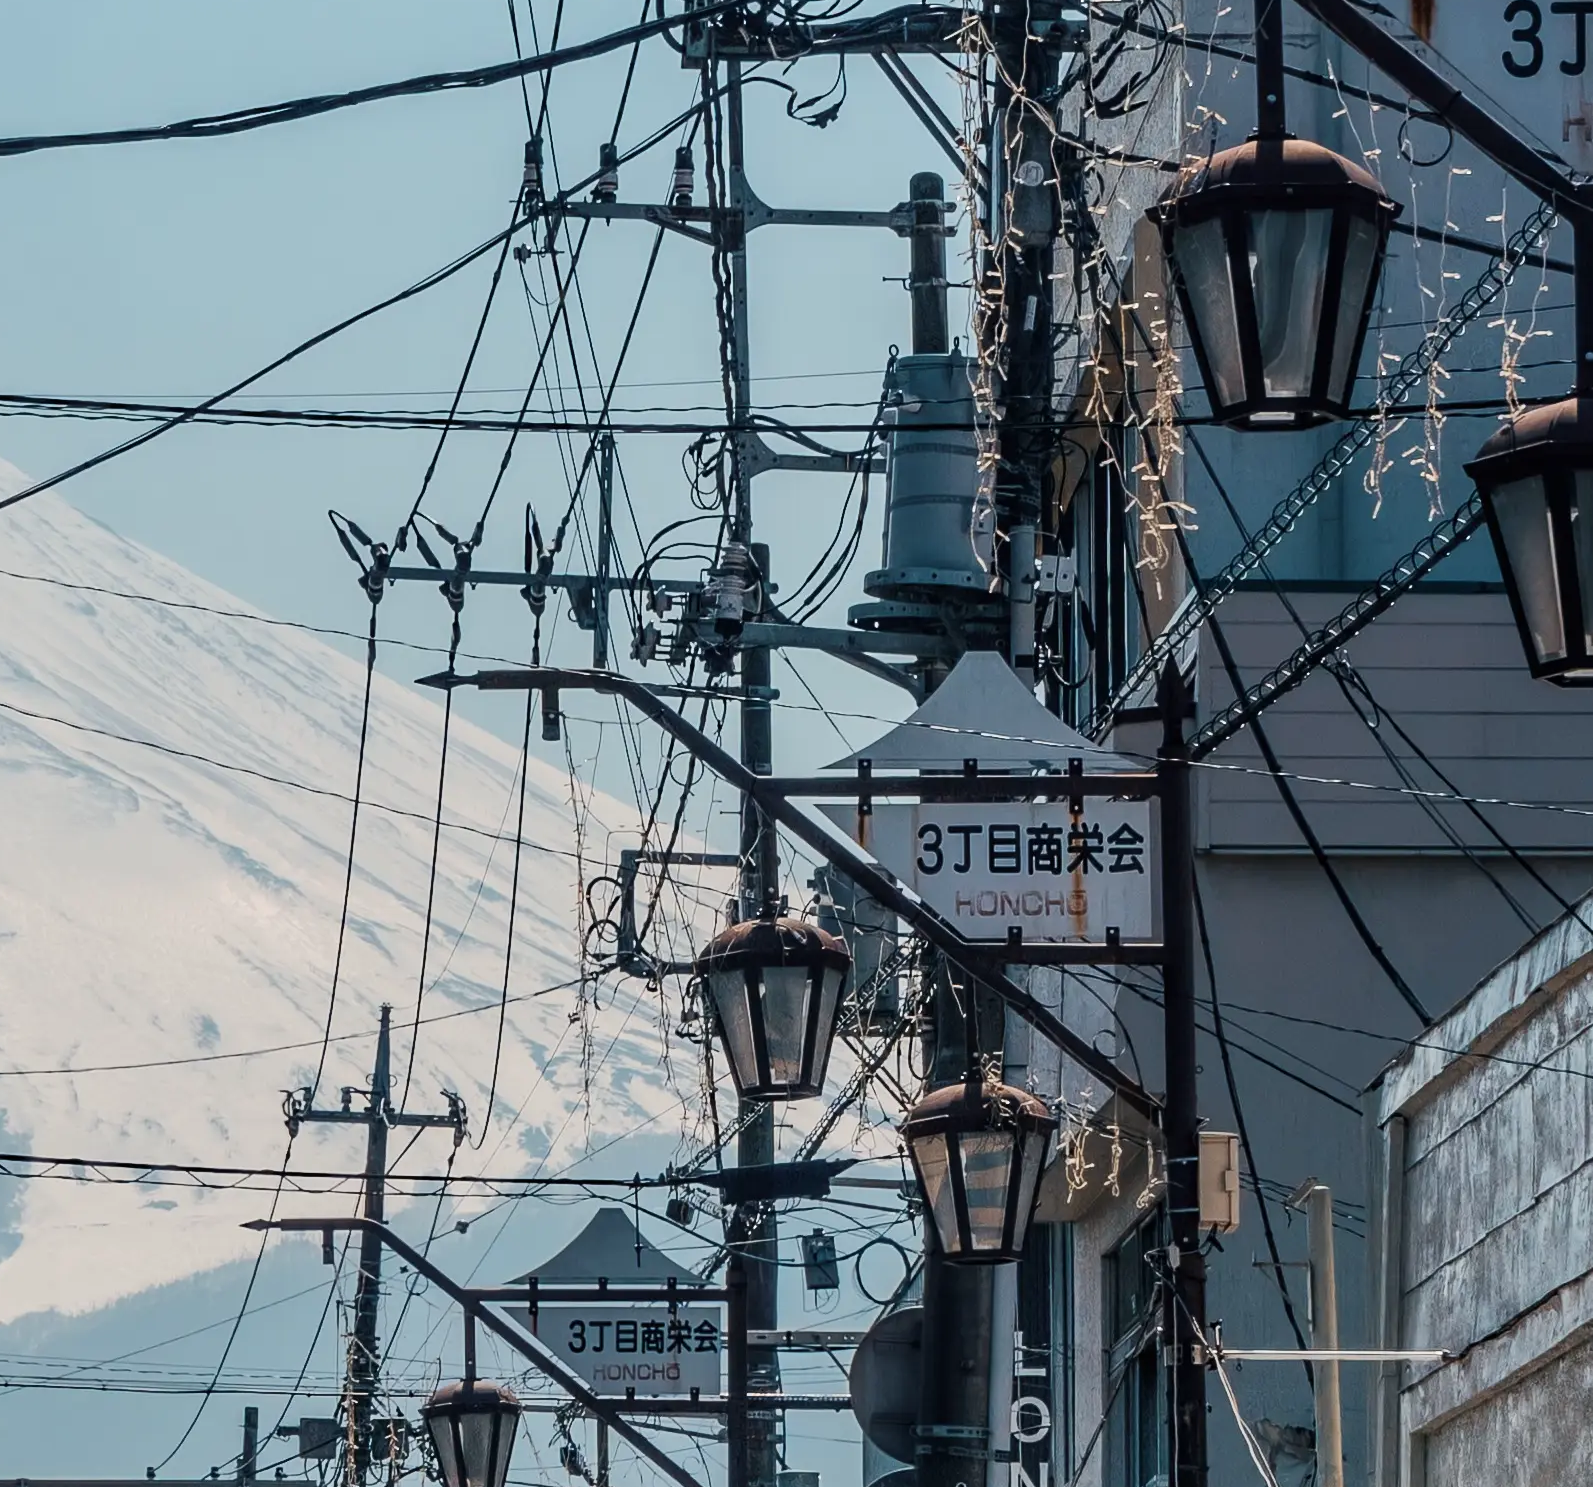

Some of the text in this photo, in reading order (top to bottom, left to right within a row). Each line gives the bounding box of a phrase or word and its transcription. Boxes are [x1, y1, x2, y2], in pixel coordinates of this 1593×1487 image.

[916, 822, 1145, 877] 3丁目商栄会
[568, 1319, 718, 1355] 3丁目商栄会
